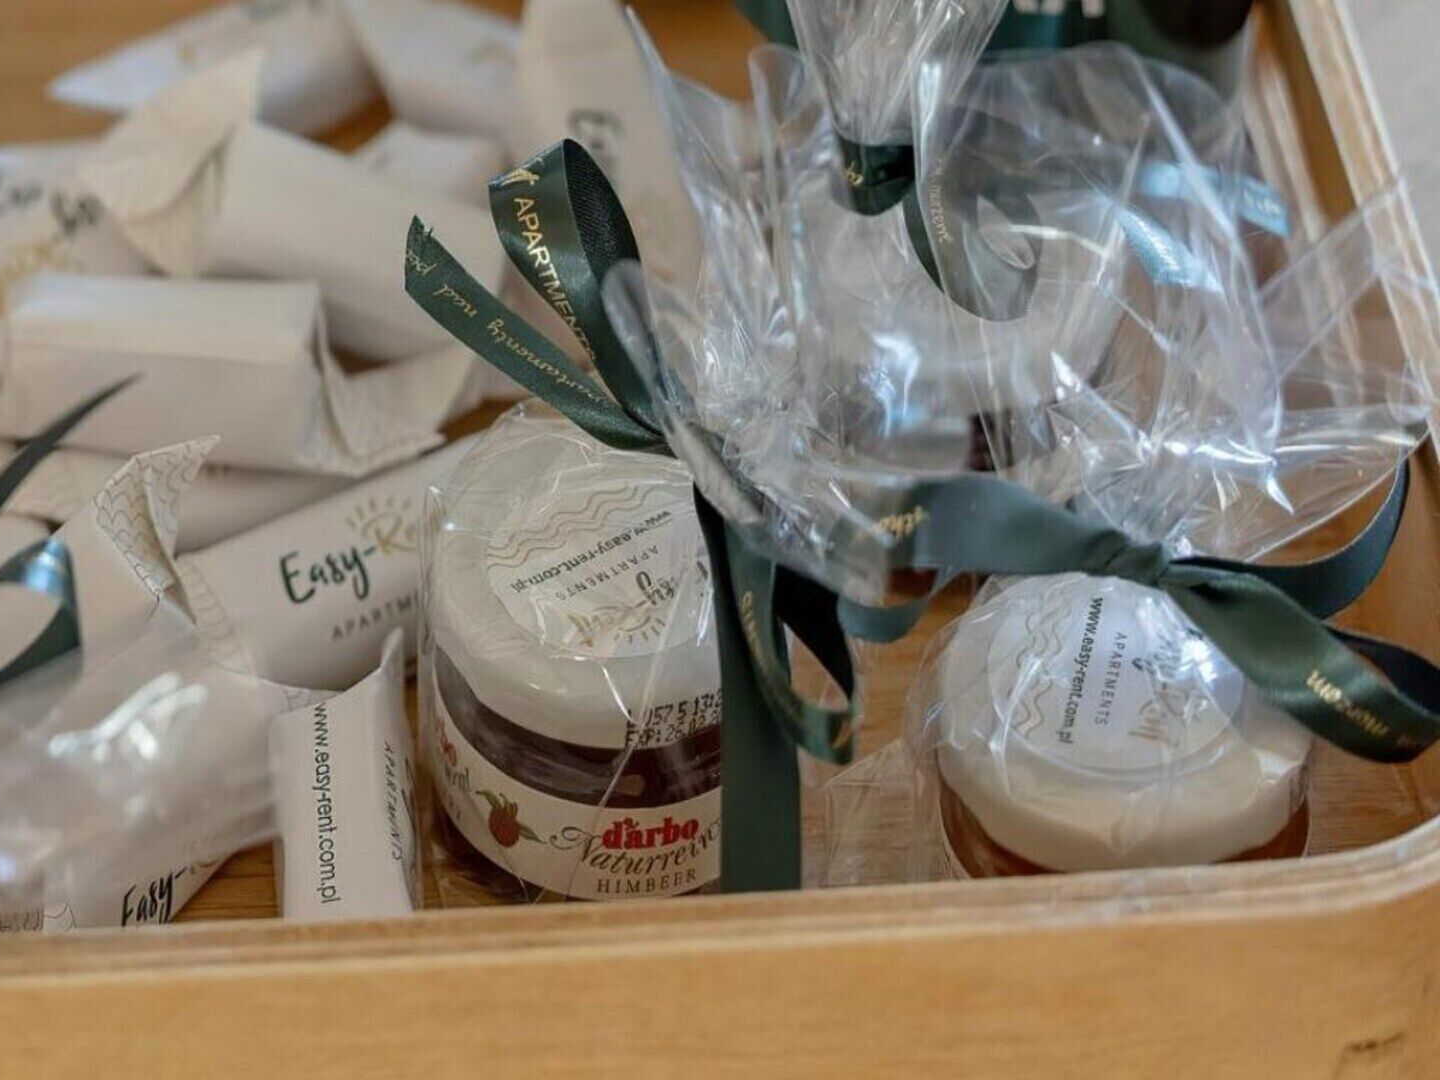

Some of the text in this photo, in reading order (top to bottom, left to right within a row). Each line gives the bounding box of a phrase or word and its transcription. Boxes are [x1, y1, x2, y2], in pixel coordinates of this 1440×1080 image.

[1056, 597, 1104, 744] www.easy-rent.com.pl
[1094, 632, 1128, 726] APARTMENTS
[312, 703, 341, 904] www.easy-rent.com.pl
[597, 868, 697, 894] HIMBEER
